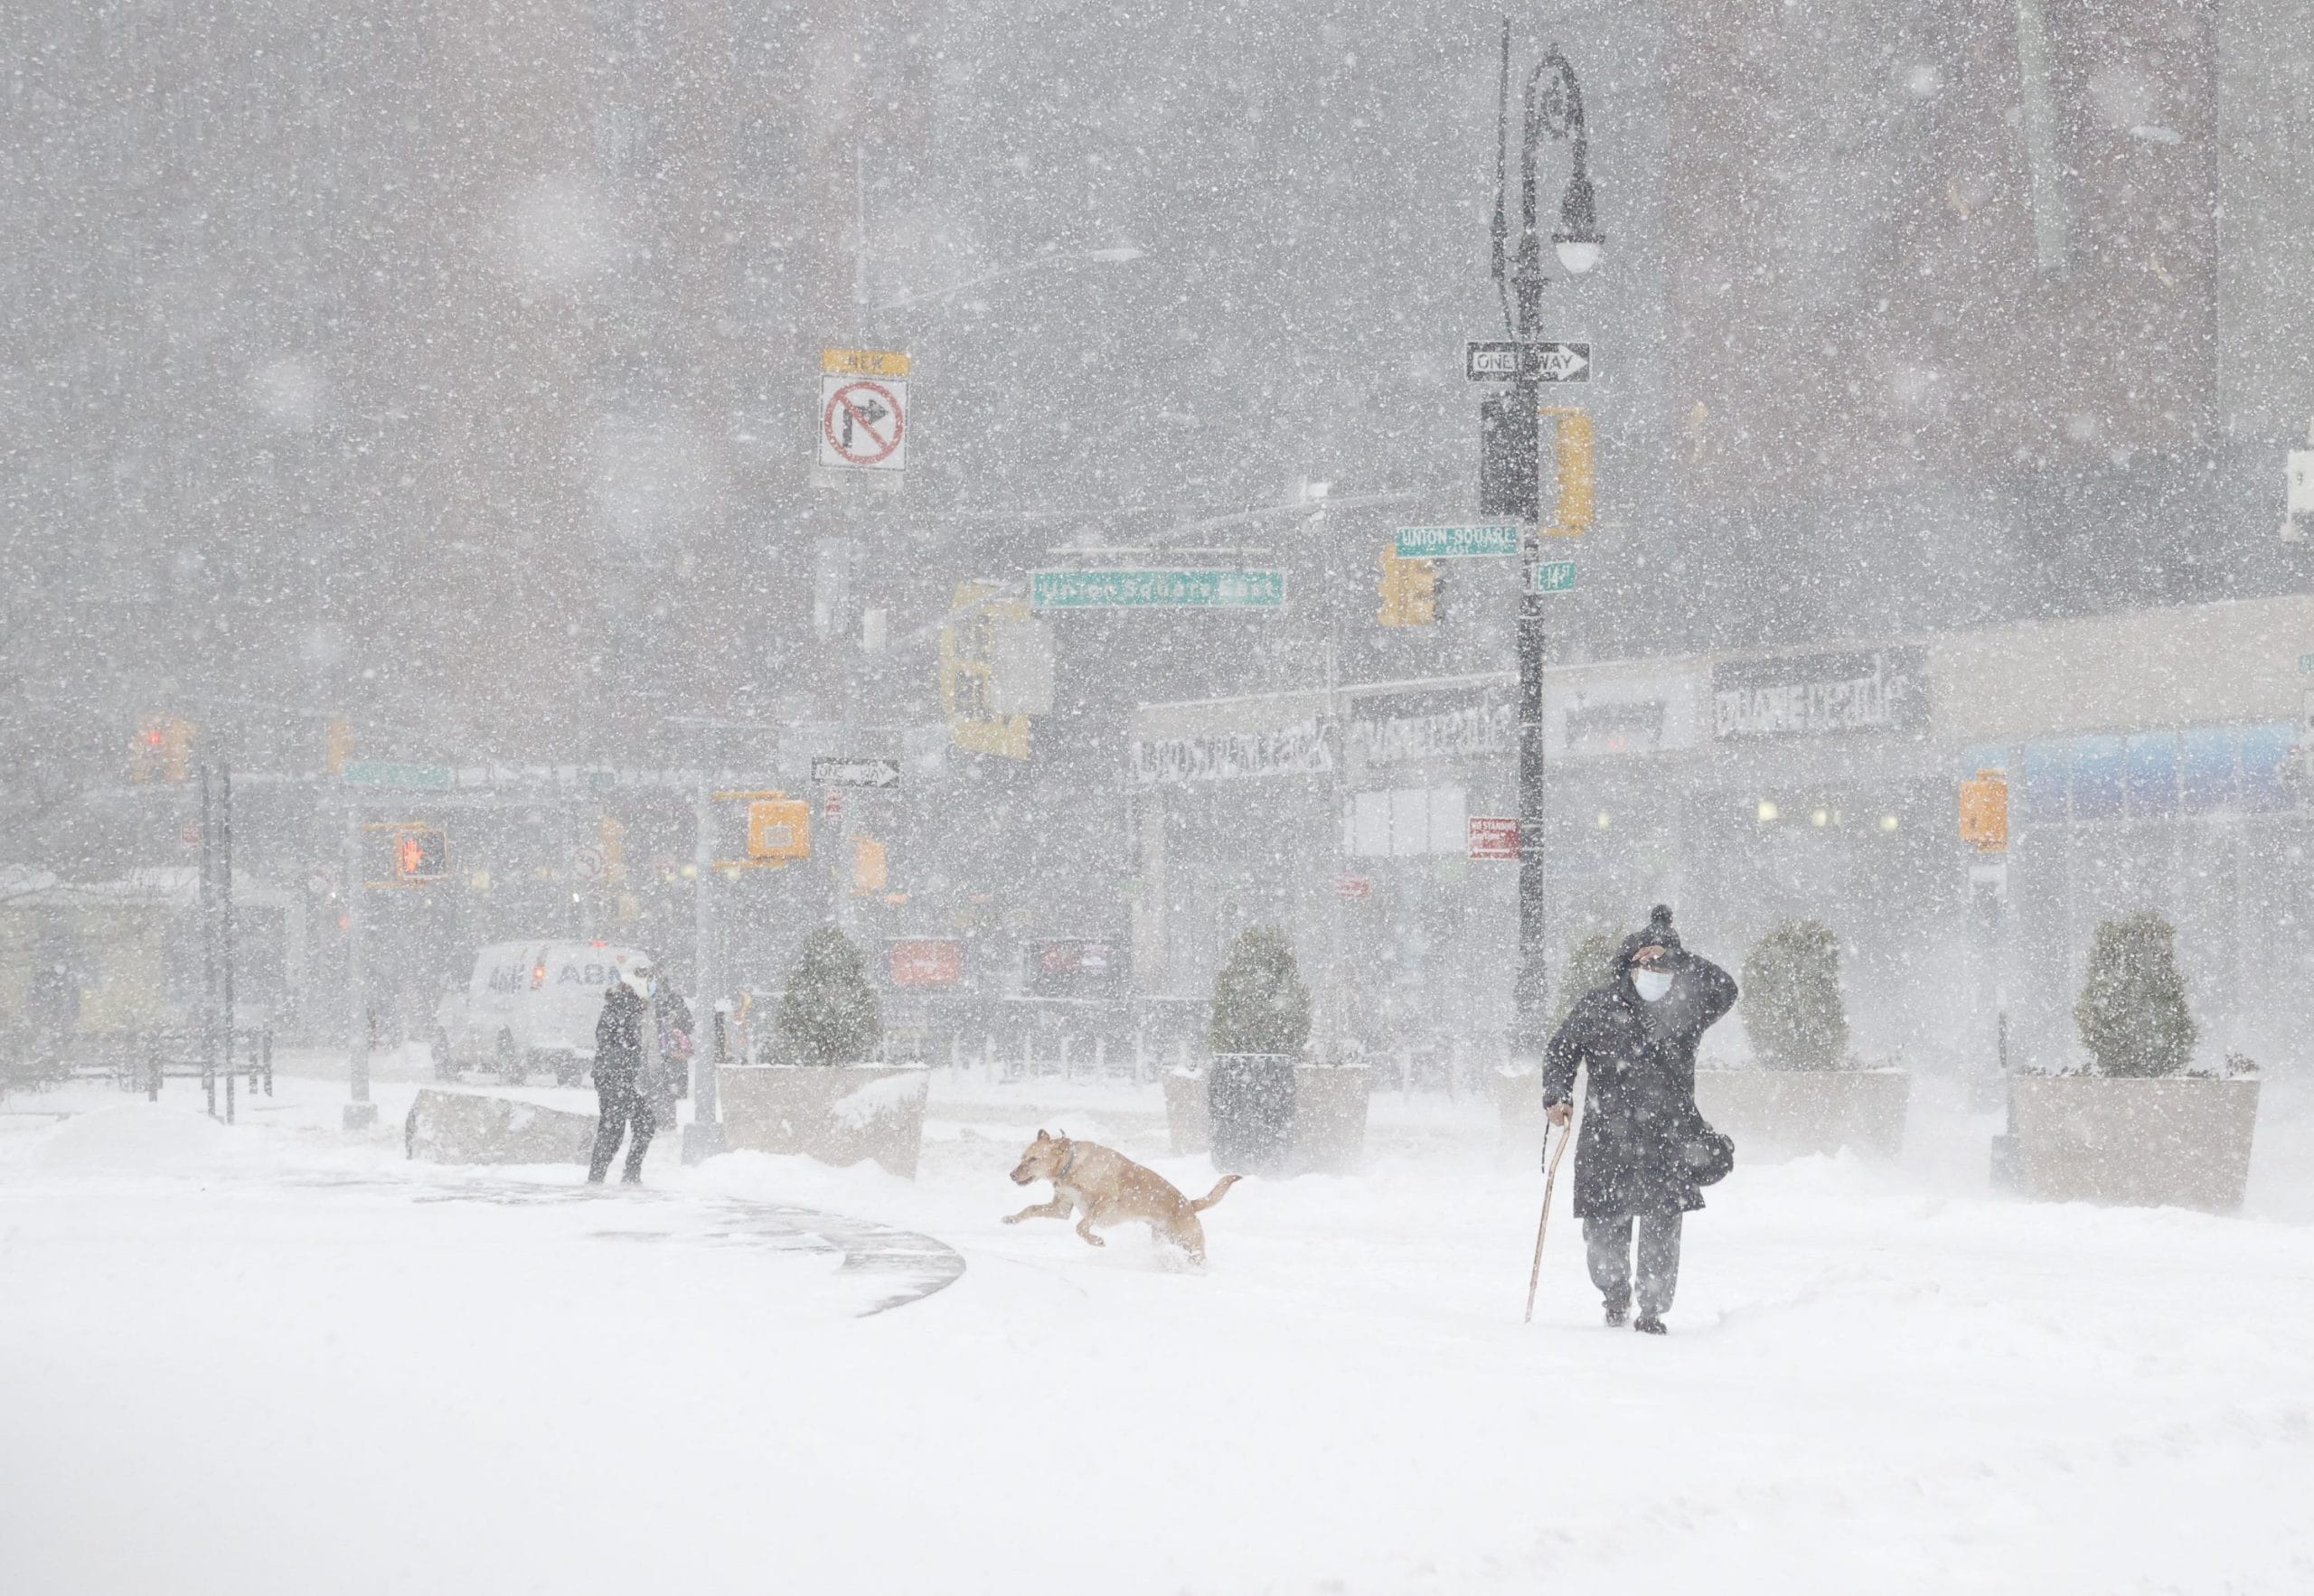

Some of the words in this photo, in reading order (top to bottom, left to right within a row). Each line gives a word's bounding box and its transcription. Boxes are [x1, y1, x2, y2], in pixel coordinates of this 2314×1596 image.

[1477, 353, 1513, 370] ONE
[1537, 353, 1572, 370] WAY
[1402, 528, 1447, 546] UNION
[1454, 527, 1513, 545] SQUARE
[1042, 580, 1115, 598] Union
[1124, 580, 1212, 600] Square
[1218, 579, 1275, 597] East
[818, 765, 842, 779] ONE
